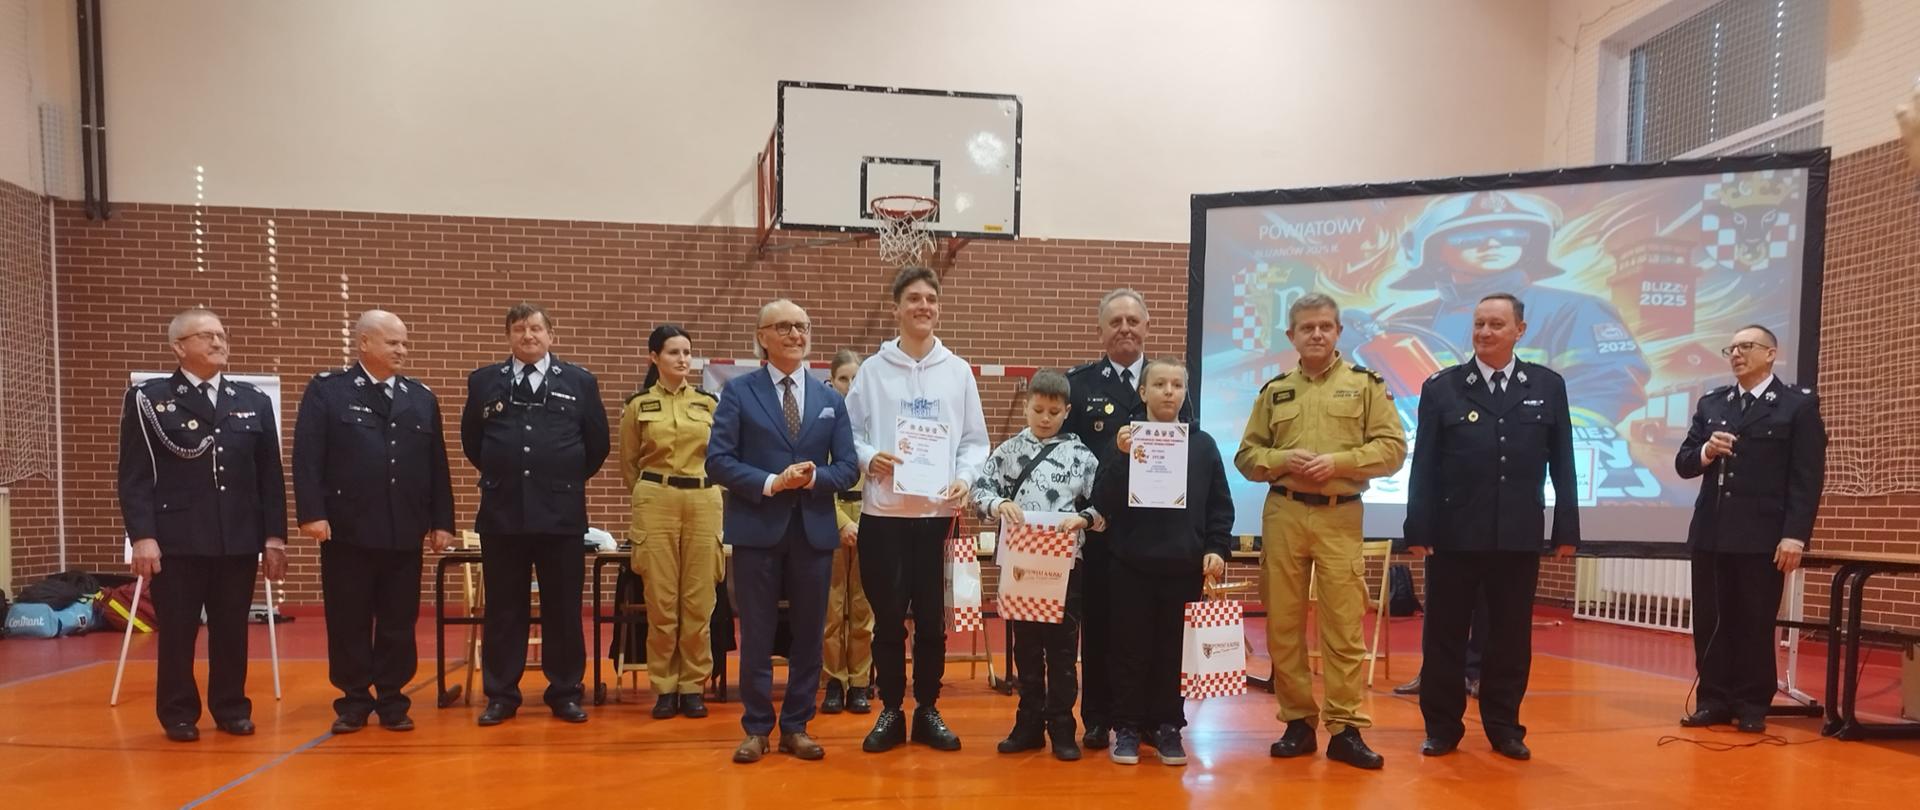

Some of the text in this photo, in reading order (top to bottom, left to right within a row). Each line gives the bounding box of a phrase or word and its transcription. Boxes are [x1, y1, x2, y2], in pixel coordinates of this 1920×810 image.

[1258, 217, 1366, 241] POWIATOWY
[1640, 293, 1687, 306] 2025
[1598, 340, 1636, 354] 2025
